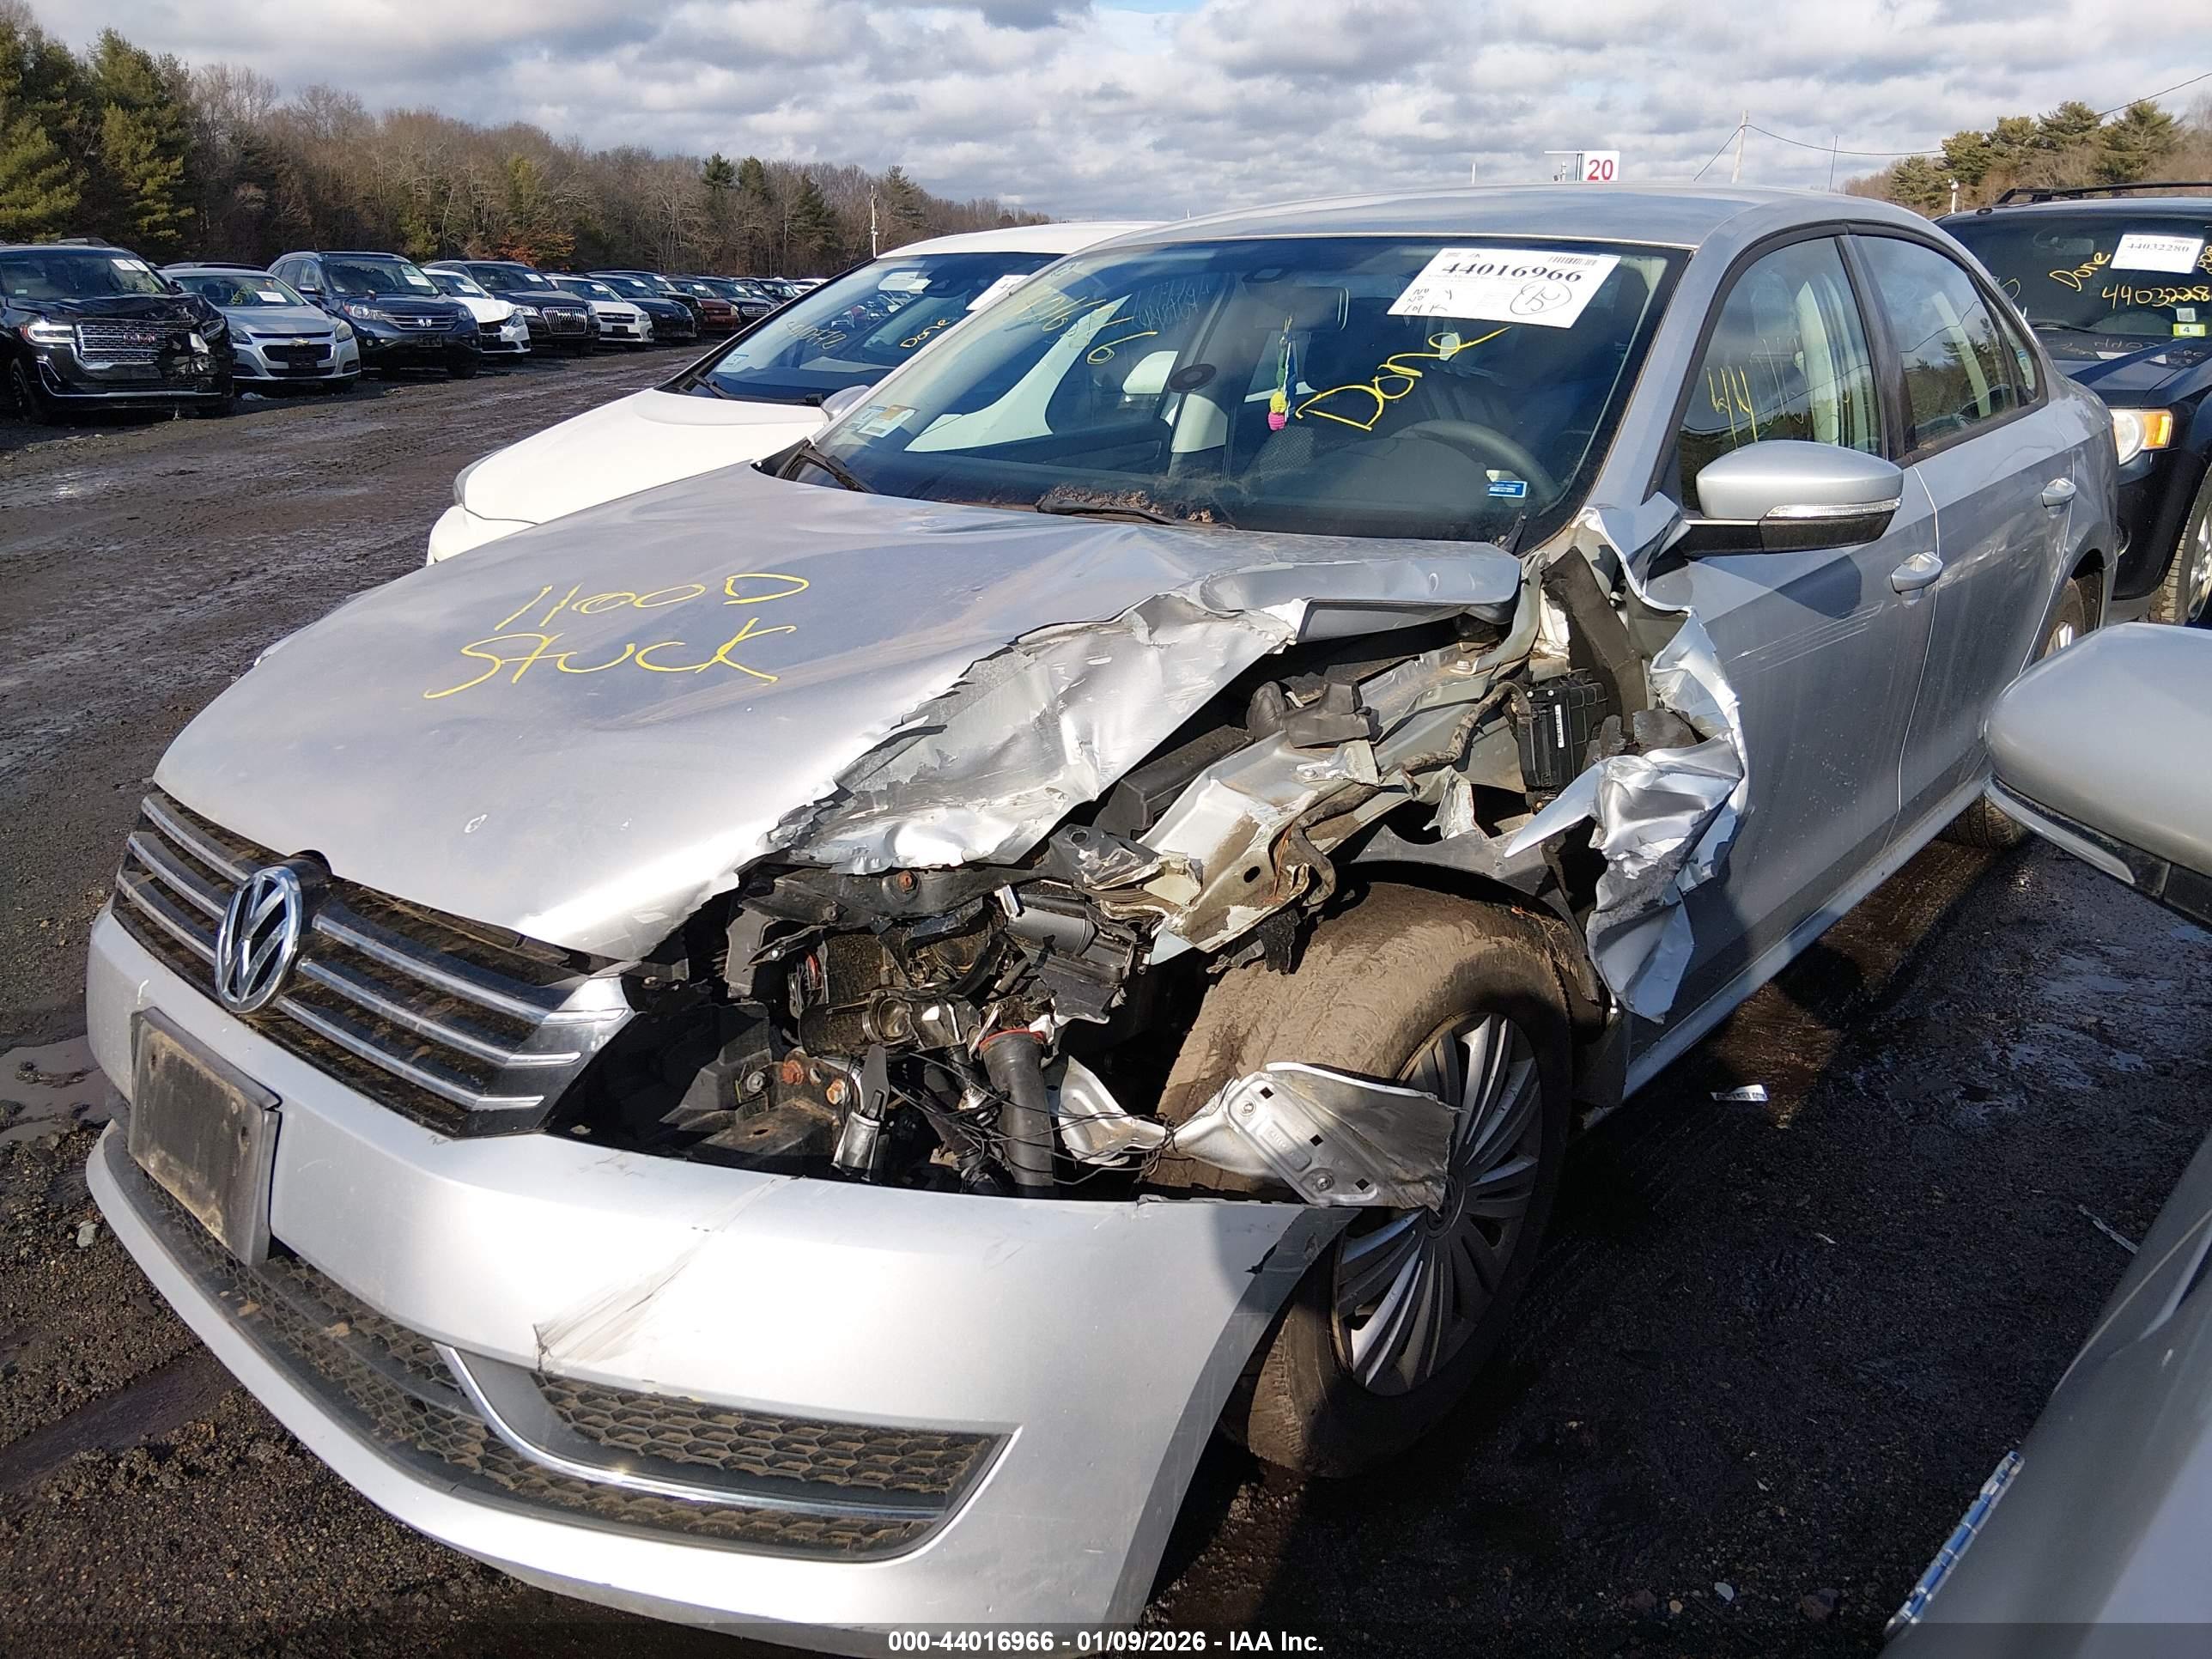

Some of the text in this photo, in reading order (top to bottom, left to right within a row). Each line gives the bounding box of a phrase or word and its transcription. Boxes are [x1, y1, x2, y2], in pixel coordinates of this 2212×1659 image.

[1587, 159, 1613, 181] 20
[1442, 262, 1585, 283] 44016966
[2049, 252, 2112, 292] Done
[2102, 283, 2212, 309] 4403228
[900, 318, 951, 349] Done
[1295, 325, 1512, 431] Done
